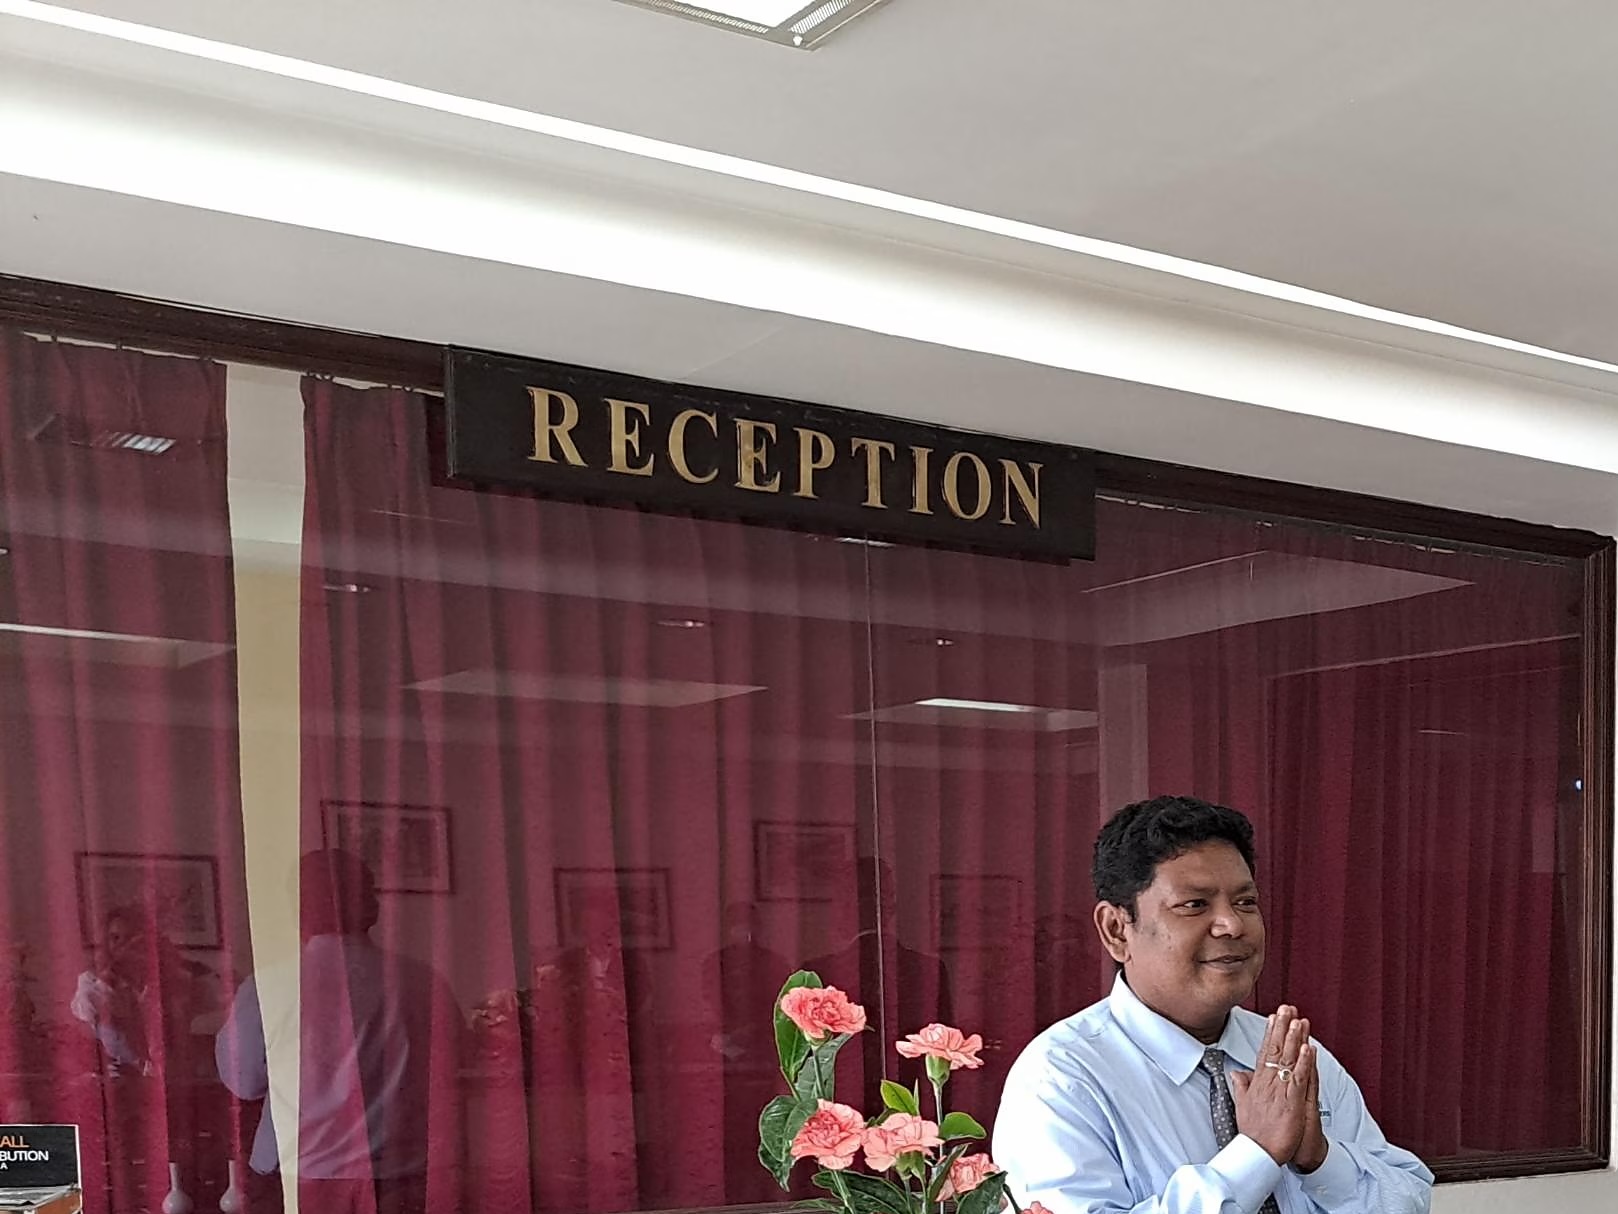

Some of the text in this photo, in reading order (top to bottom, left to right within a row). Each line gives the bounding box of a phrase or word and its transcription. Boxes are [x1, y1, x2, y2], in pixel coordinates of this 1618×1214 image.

[526, 385, 1044, 529] RECEPTION
[0, 1135, 30, 1148] ALL
[0, 1150, 49, 1161] BUTION
